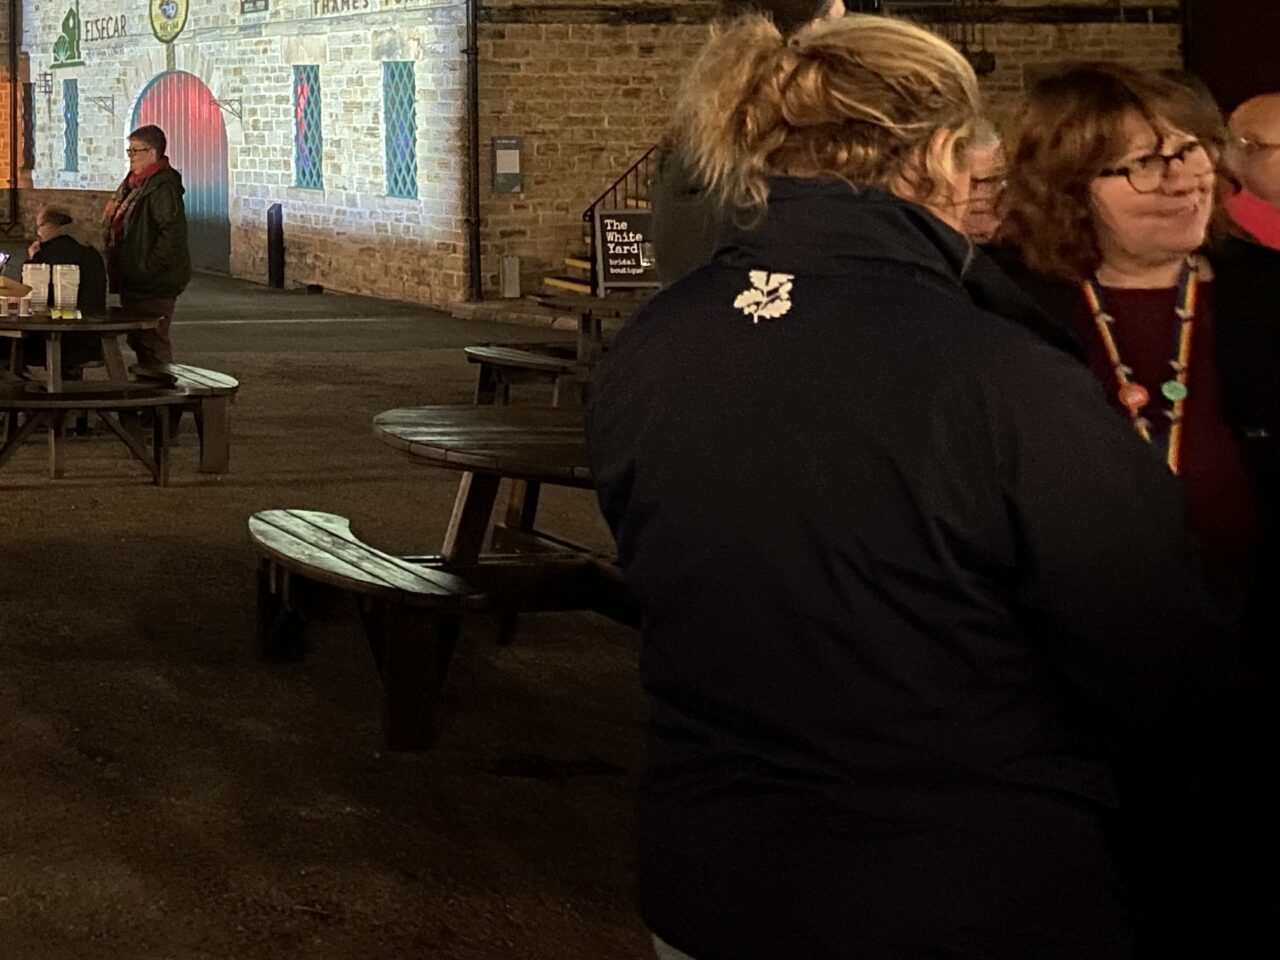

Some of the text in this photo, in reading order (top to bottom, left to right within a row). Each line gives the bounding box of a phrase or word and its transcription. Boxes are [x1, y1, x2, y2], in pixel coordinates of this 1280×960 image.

[604, 219, 628, 230] The
[606, 231, 643, 242] White
[607, 243, 638, 254] Yard
[610, 267, 644, 276] boutique
